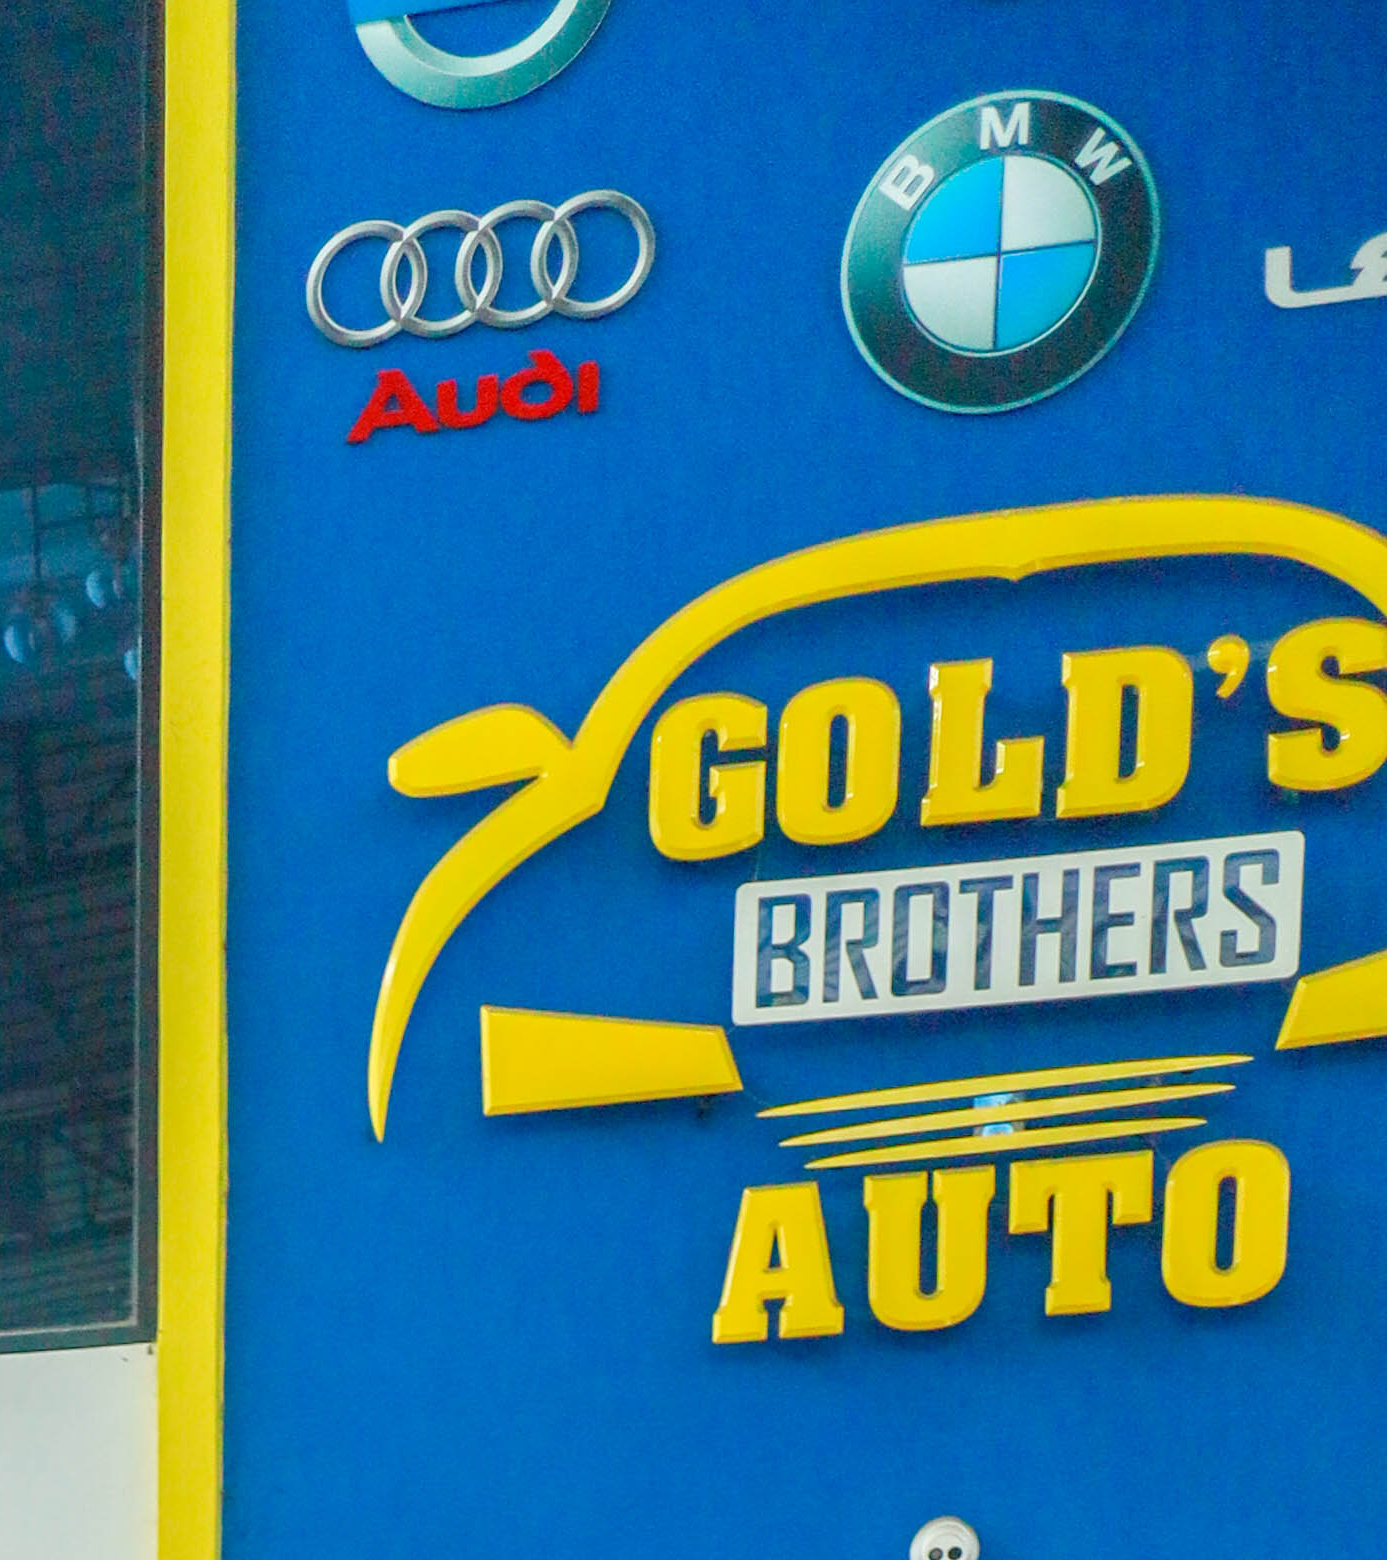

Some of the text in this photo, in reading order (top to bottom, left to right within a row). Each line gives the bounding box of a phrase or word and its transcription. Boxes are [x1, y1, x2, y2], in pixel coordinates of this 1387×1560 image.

[879, 102, 1132, 211] BMW
[347, 349, 601, 444] Audi
[648, 618, 1387, 864] GOLD'S
[754, 847, 1280, 1010] BROTHERS
[711, 1139, 1291, 1345] AUTO
